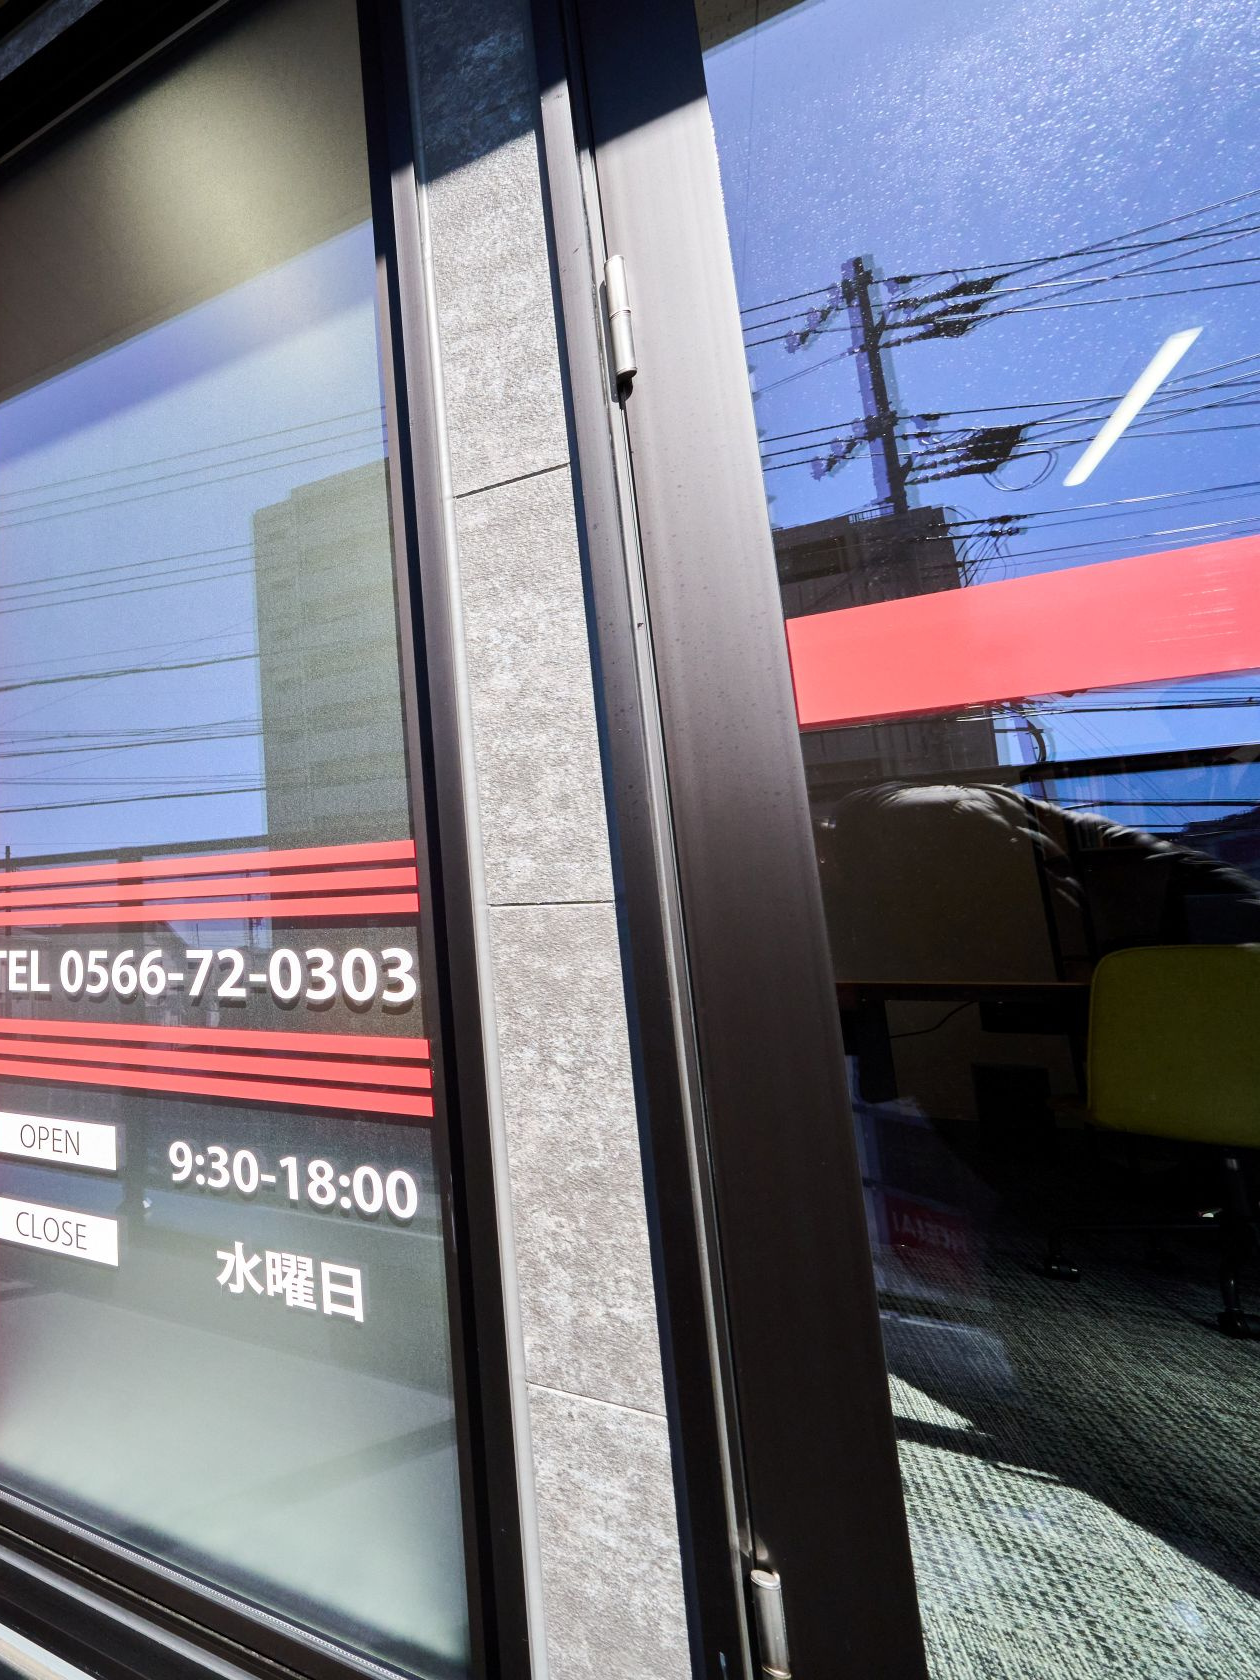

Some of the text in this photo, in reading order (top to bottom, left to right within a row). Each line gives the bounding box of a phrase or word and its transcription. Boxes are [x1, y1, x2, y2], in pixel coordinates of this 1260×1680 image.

[60, 947, 418, 1002] 0566-72-0303
[19, 1123, 81, 1156] OPEN
[168, 1140, 418, 1220] 9:30-18:00
[15, 1210, 88, 1251] CLOSE
[215, 1241, 365, 1323] 水曜日
